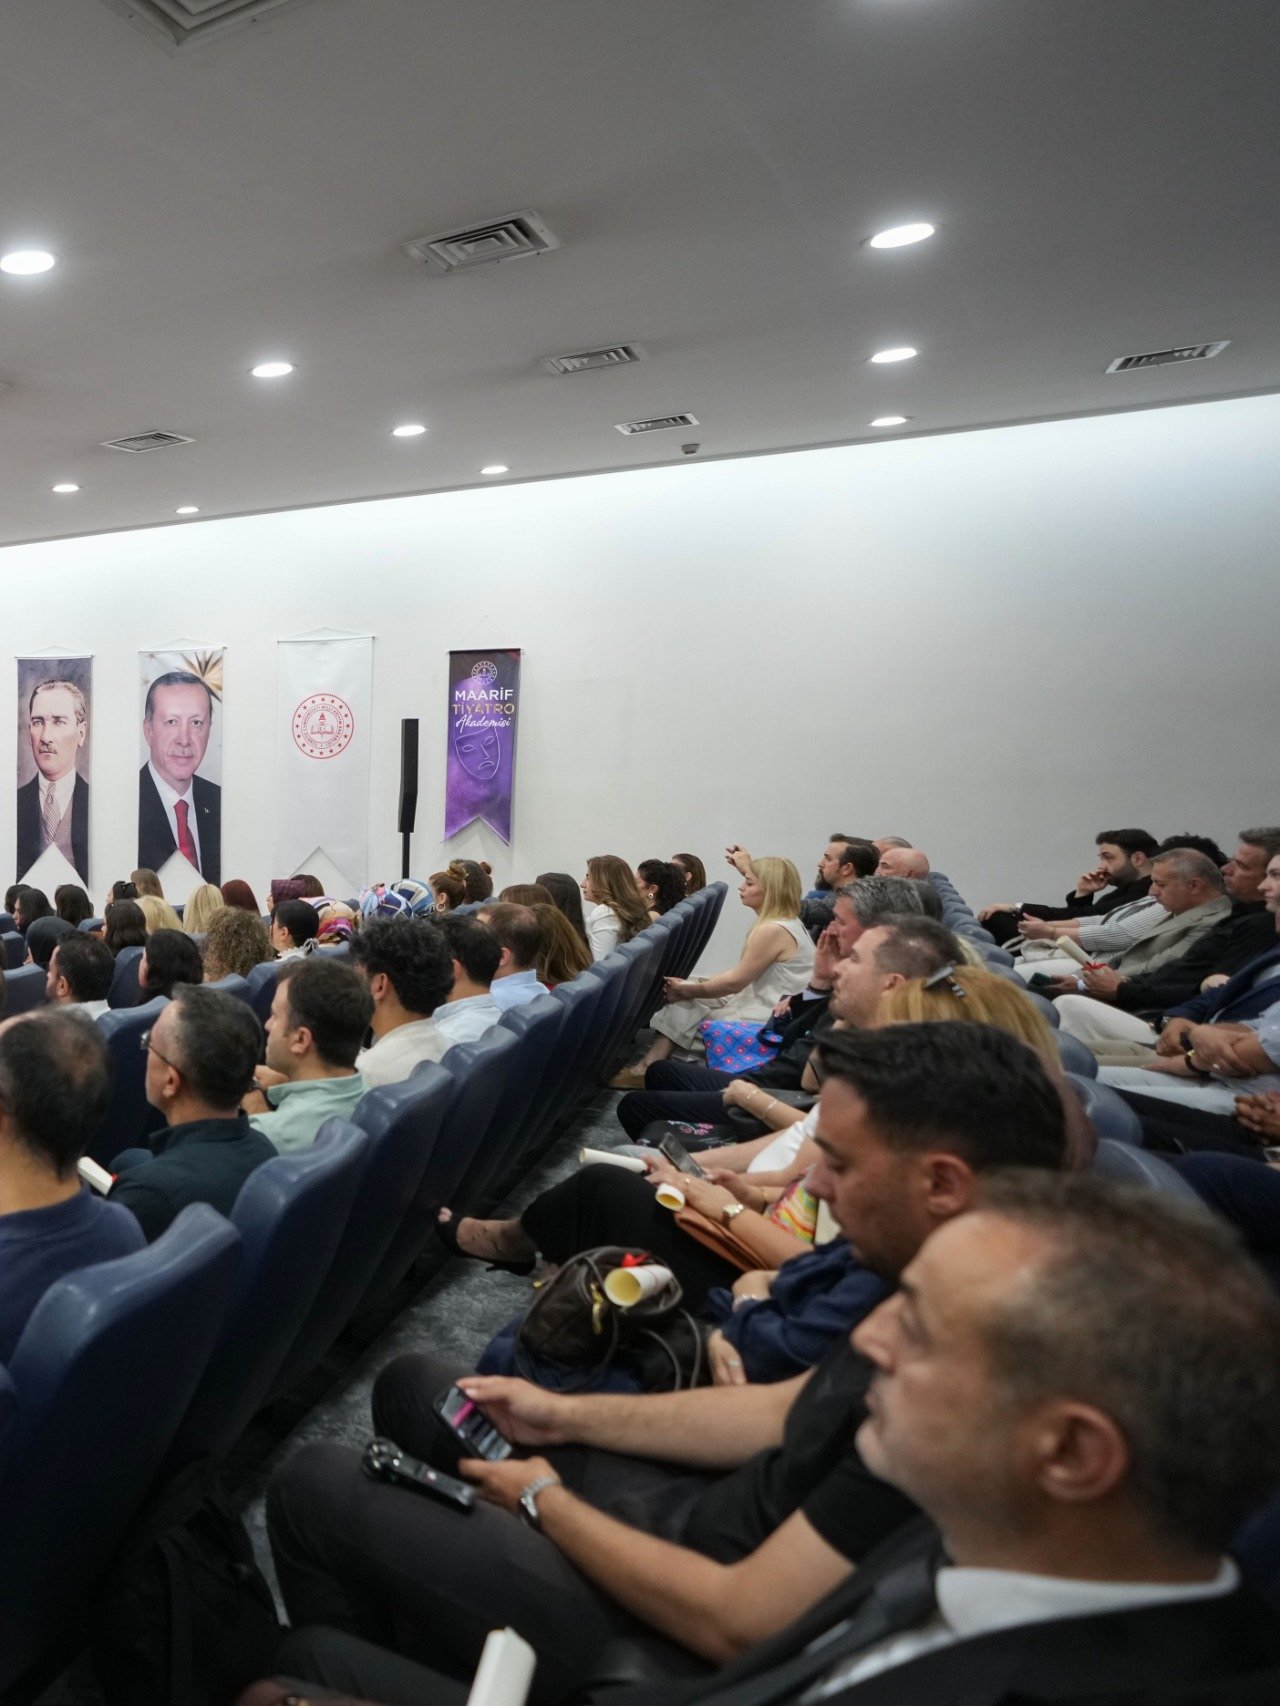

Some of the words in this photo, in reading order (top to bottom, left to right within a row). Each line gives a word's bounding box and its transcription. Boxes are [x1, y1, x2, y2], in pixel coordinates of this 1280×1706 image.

[455, 687, 514, 701] MAARİF
[452, 702, 515, 715] TİYATRO
[455, 714, 511, 733] Akademisi
